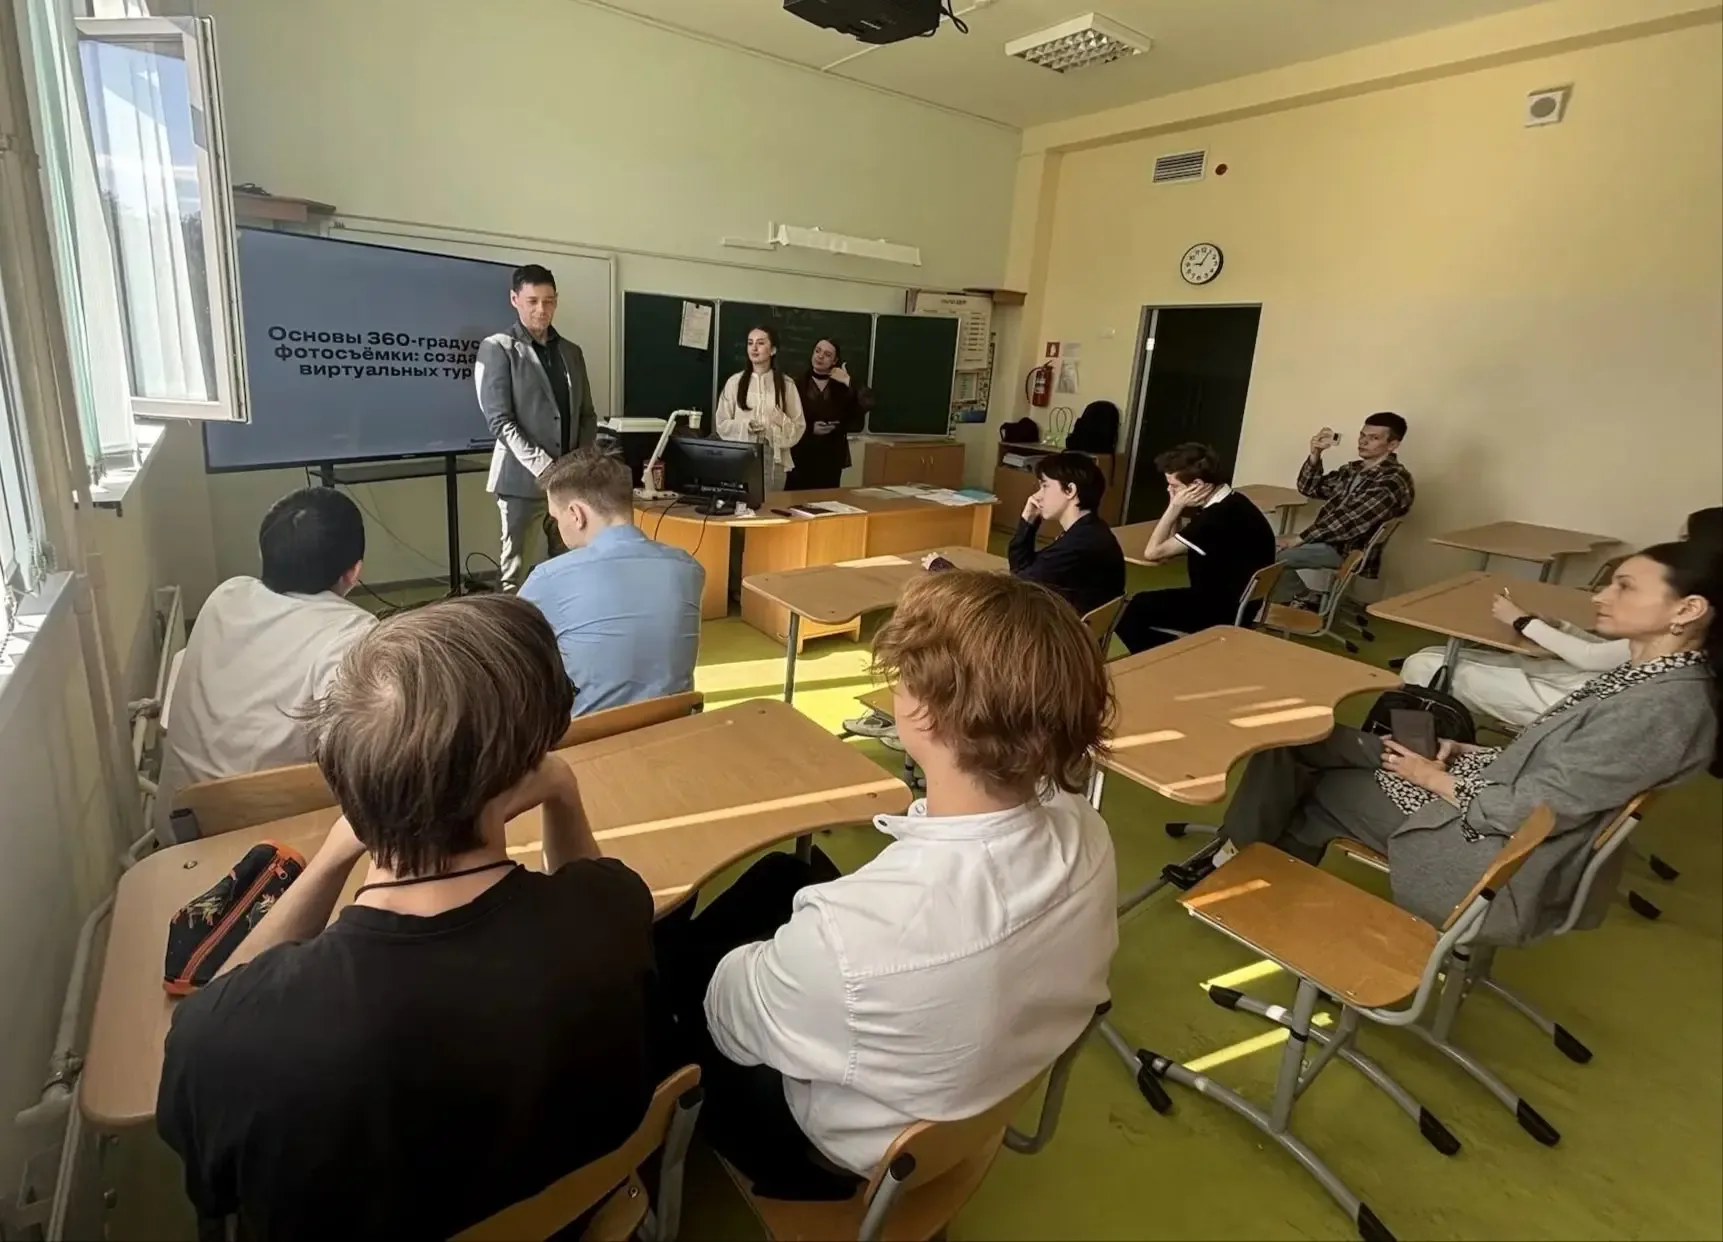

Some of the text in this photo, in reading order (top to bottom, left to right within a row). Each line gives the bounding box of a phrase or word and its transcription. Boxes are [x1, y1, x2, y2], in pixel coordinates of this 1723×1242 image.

[268, 326, 362, 344] Основы
[274, 344, 420, 362] фотосъёмки:
[299, 364, 438, 378] виртуальных
